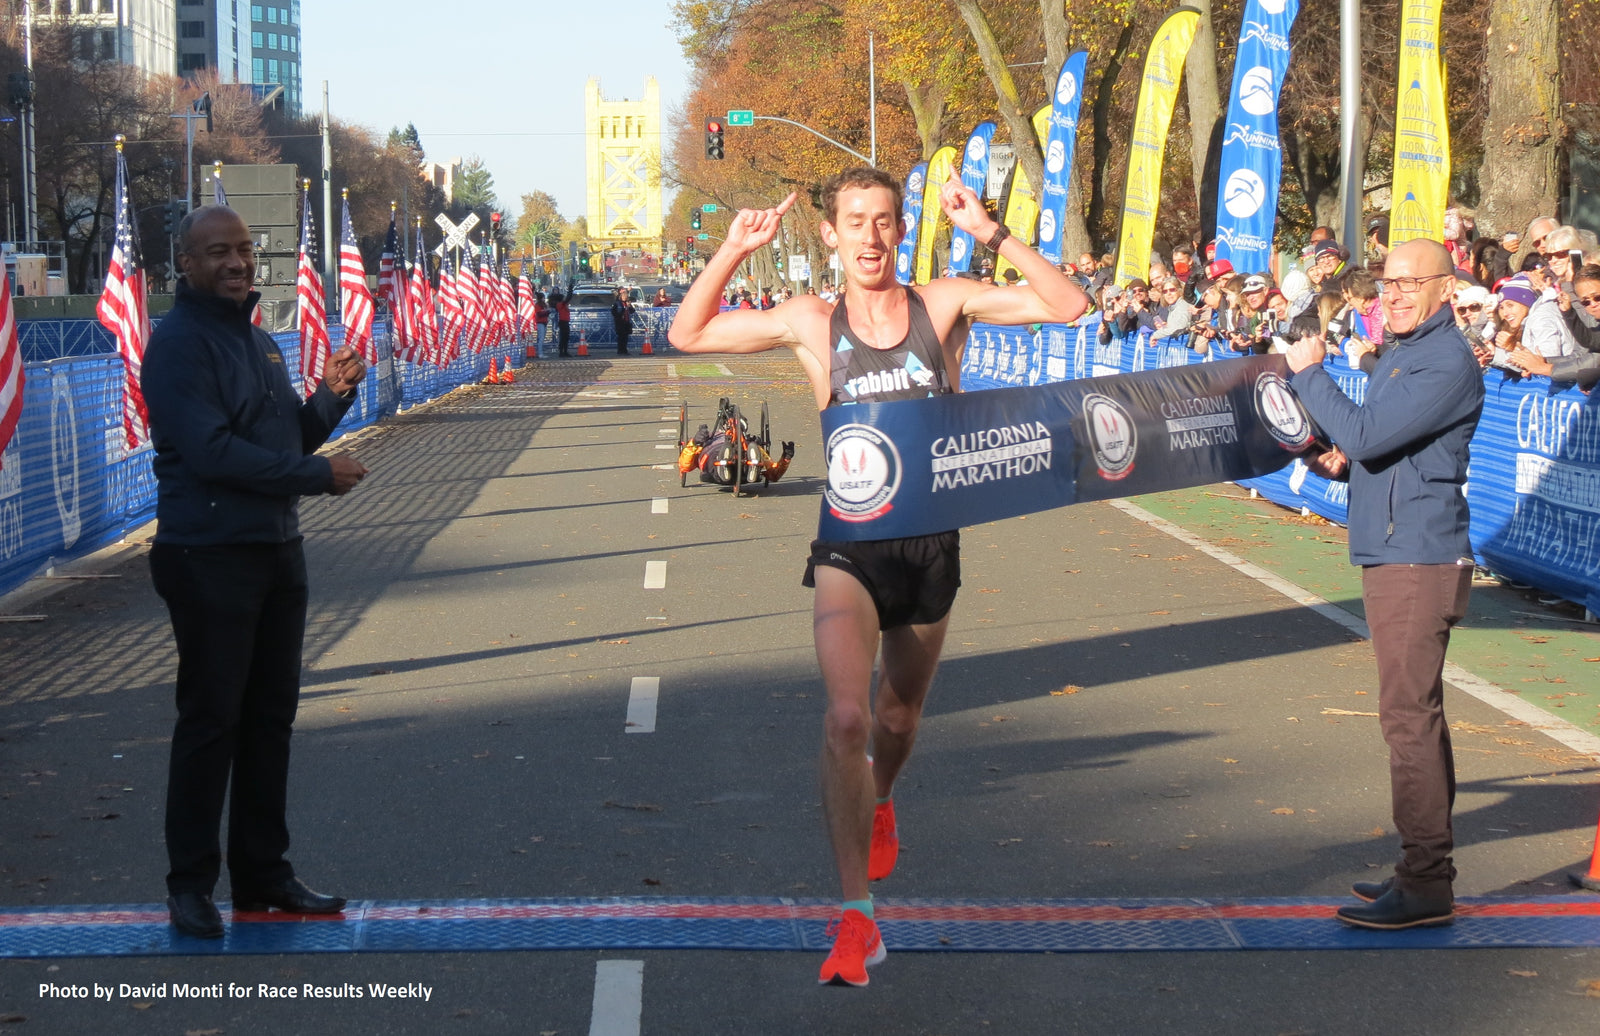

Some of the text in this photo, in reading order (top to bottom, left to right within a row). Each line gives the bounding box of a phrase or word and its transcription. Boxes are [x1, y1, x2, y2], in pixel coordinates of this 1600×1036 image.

[848, 367, 911, 397] rabbit
[1160, 394, 1233, 419] CALIFORNIA
[930, 420, 1052, 457] CALIFORNIA
[1169, 425, 1238, 452] MARATHON
[931, 438, 1052, 472] INTERNATIONAL
[838, 479, 873, 490] USATF
[931, 452, 1052, 493] MARATHON
